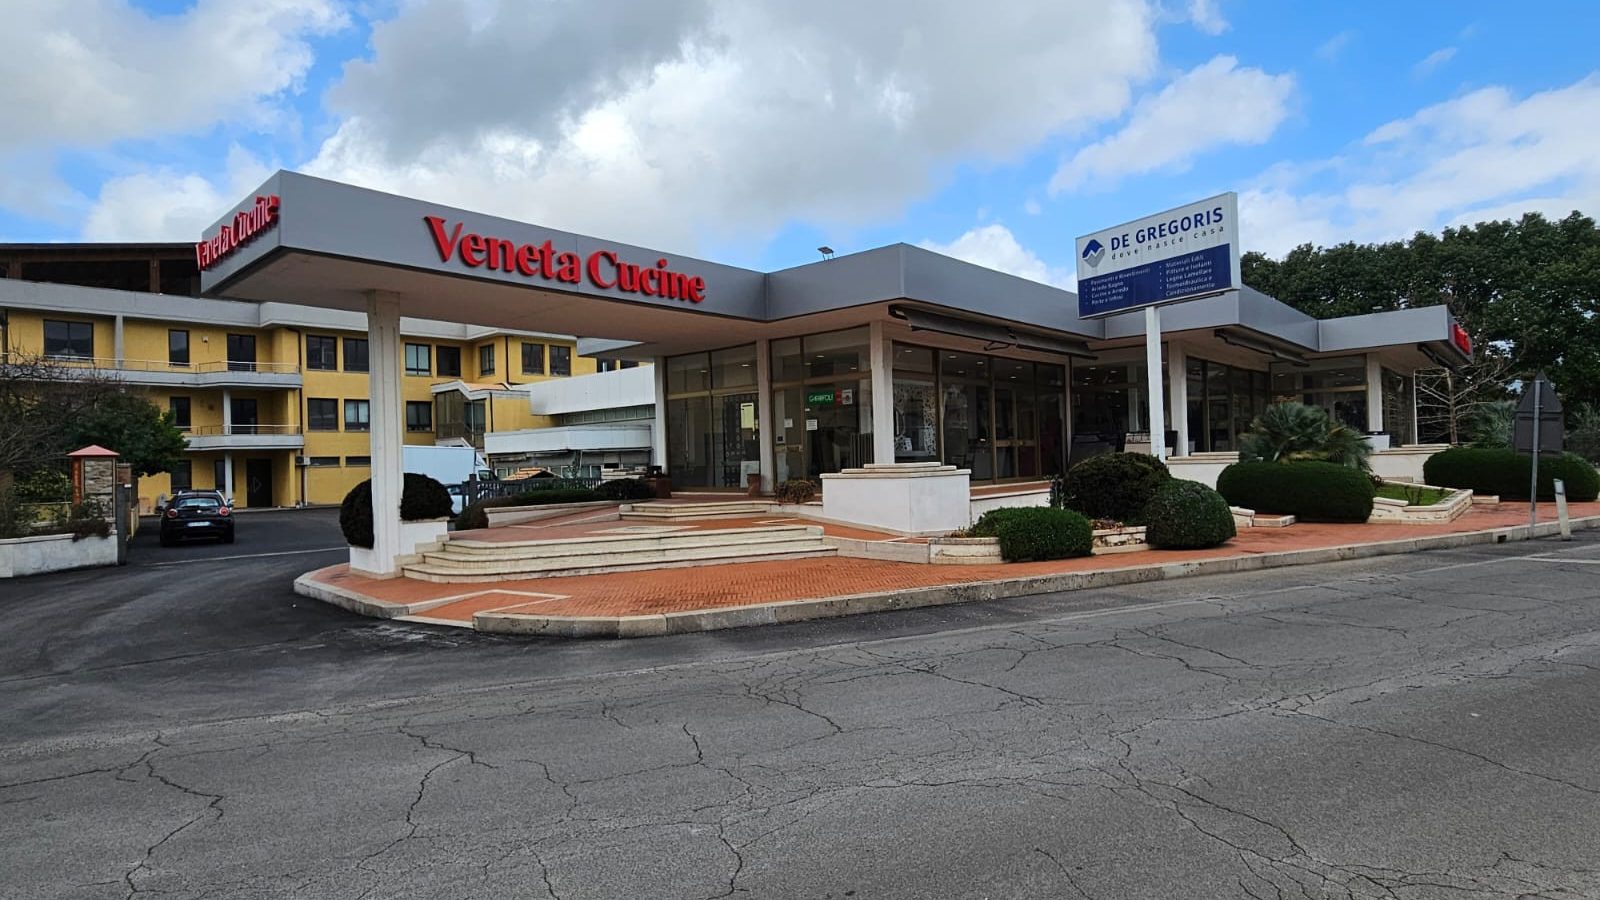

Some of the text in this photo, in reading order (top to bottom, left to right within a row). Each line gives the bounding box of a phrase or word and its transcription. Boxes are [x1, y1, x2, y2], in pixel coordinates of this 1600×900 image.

[1111, 207, 1224, 251] DE GREGORIS
[1112, 226, 1224, 260] dove nasce casa
[424, 215, 706, 303] Veneta Cucine
